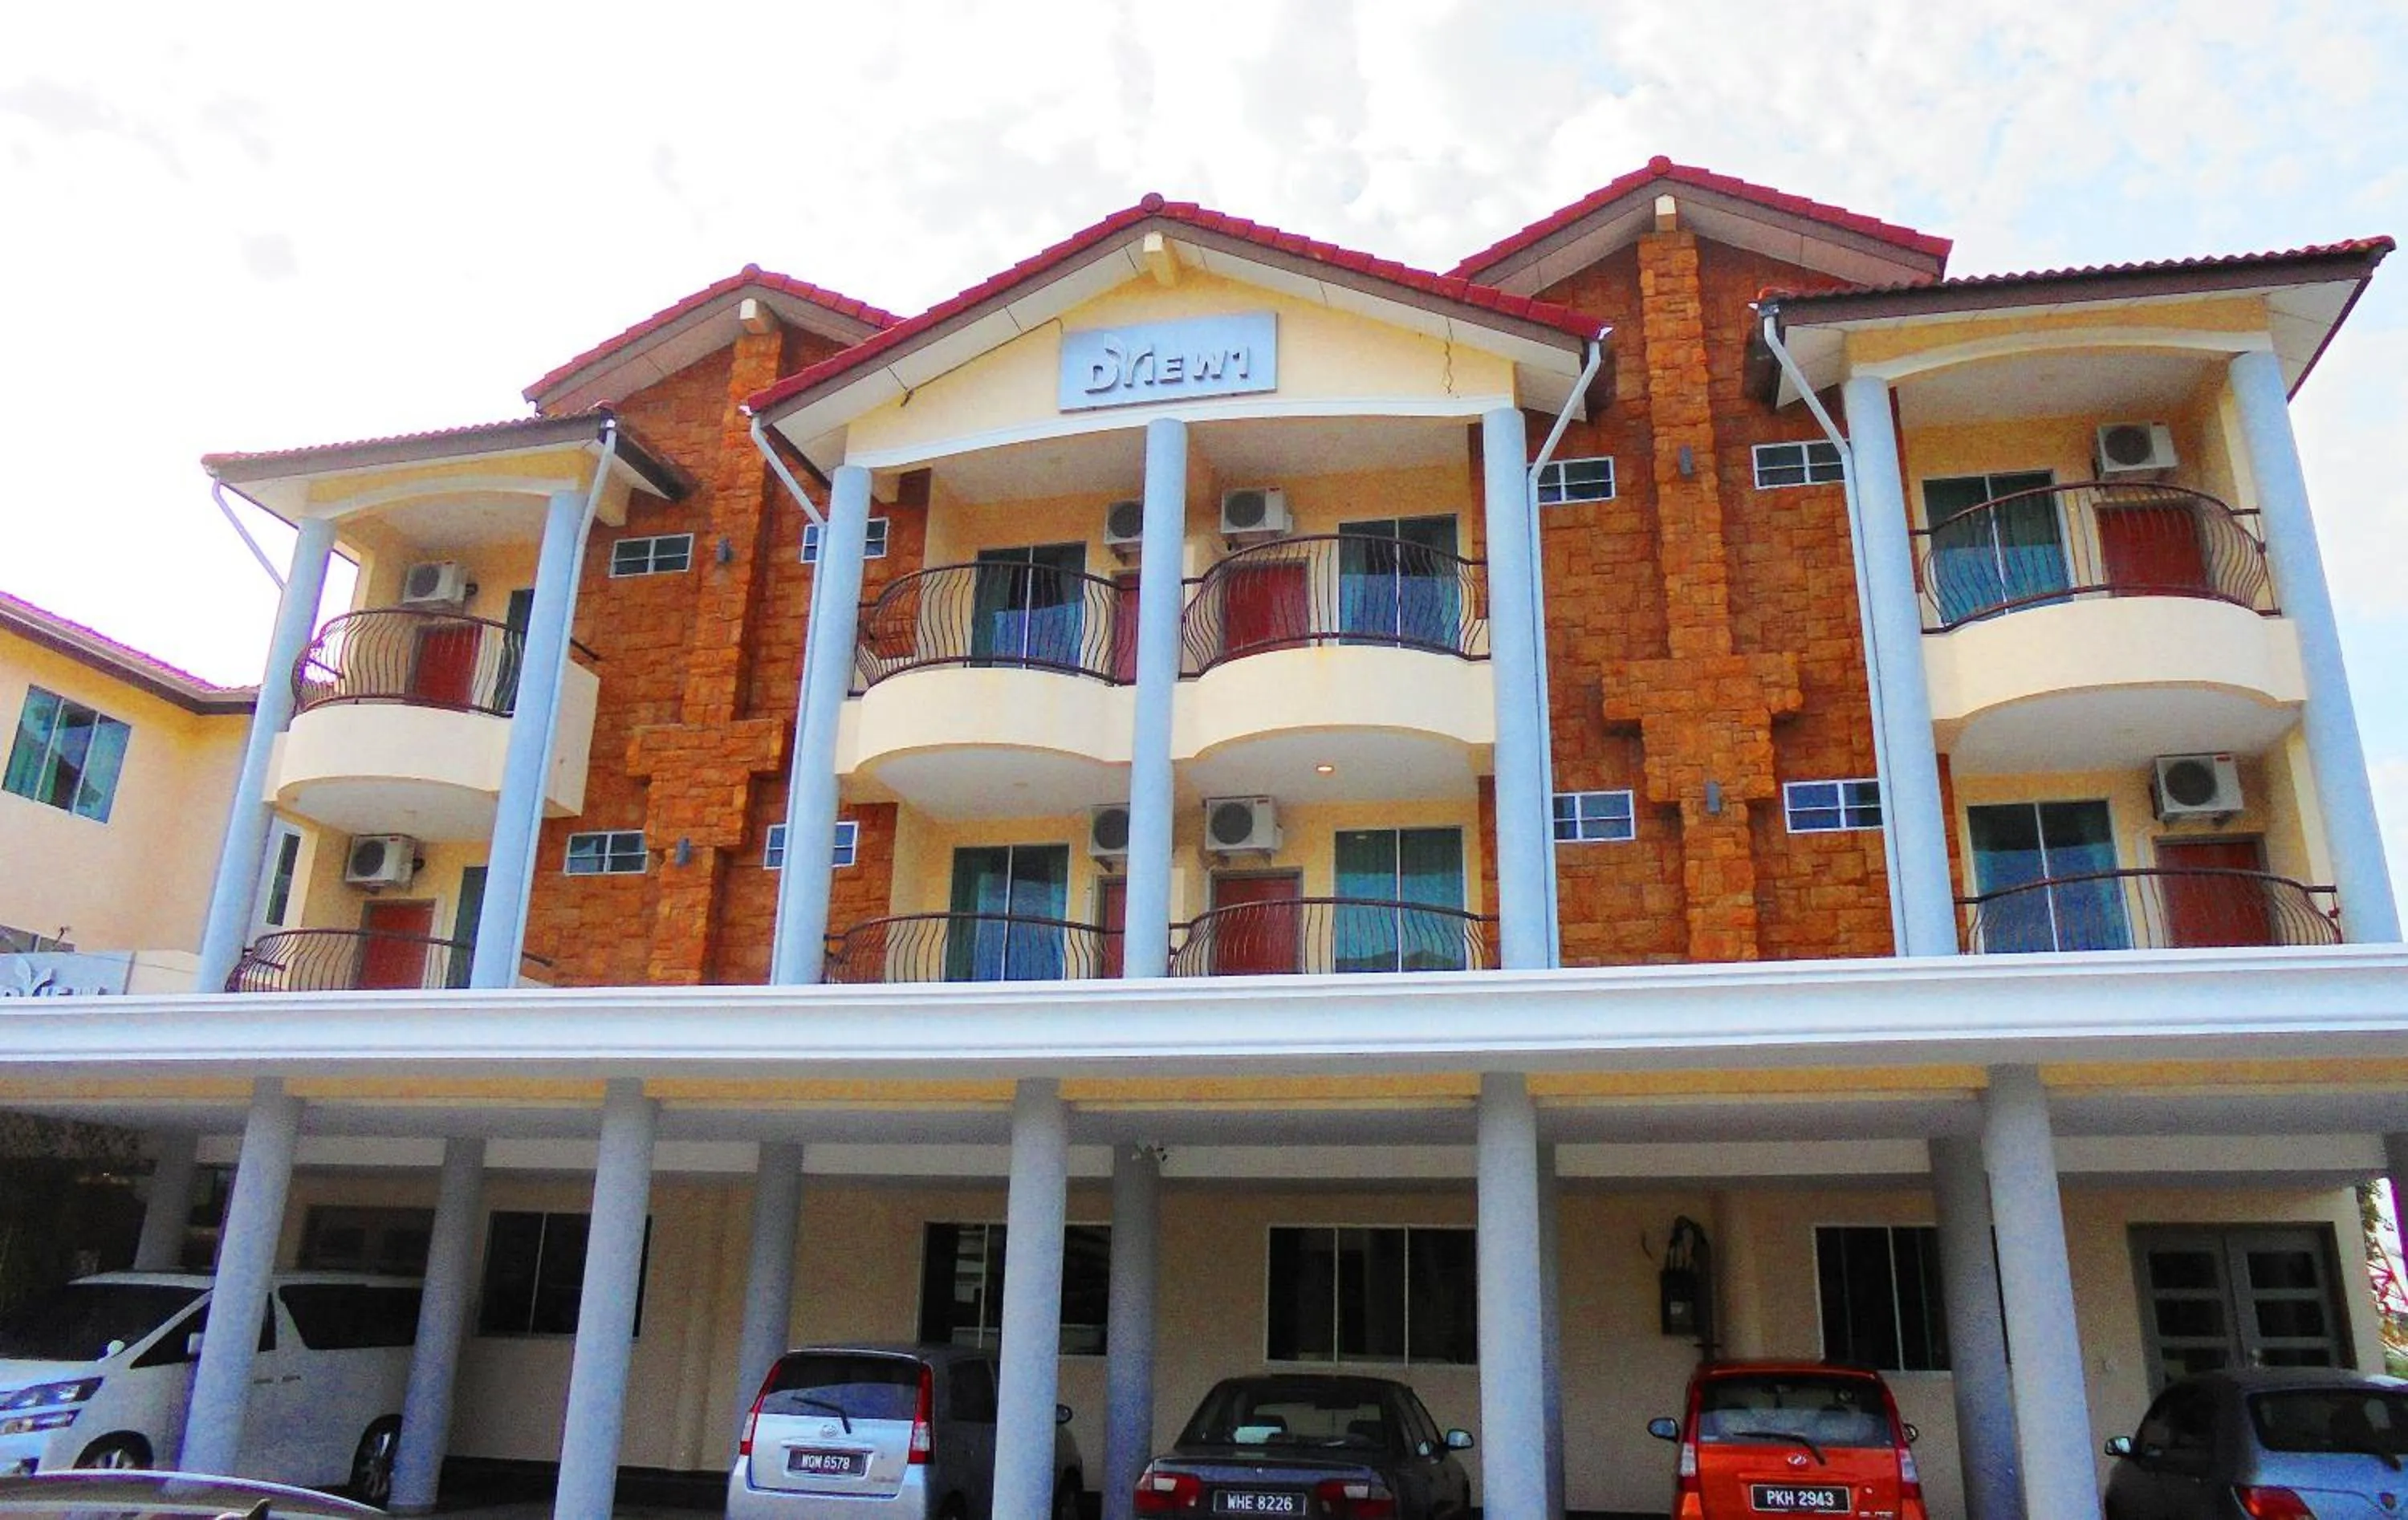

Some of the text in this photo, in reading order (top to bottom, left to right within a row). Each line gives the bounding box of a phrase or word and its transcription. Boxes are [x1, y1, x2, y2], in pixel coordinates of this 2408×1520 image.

[824, 1455, 850, 1470] 6578
[1227, 1494, 1293, 1511] WHE 8226
[1767, 1490, 1834, 1506] PKH 2943
